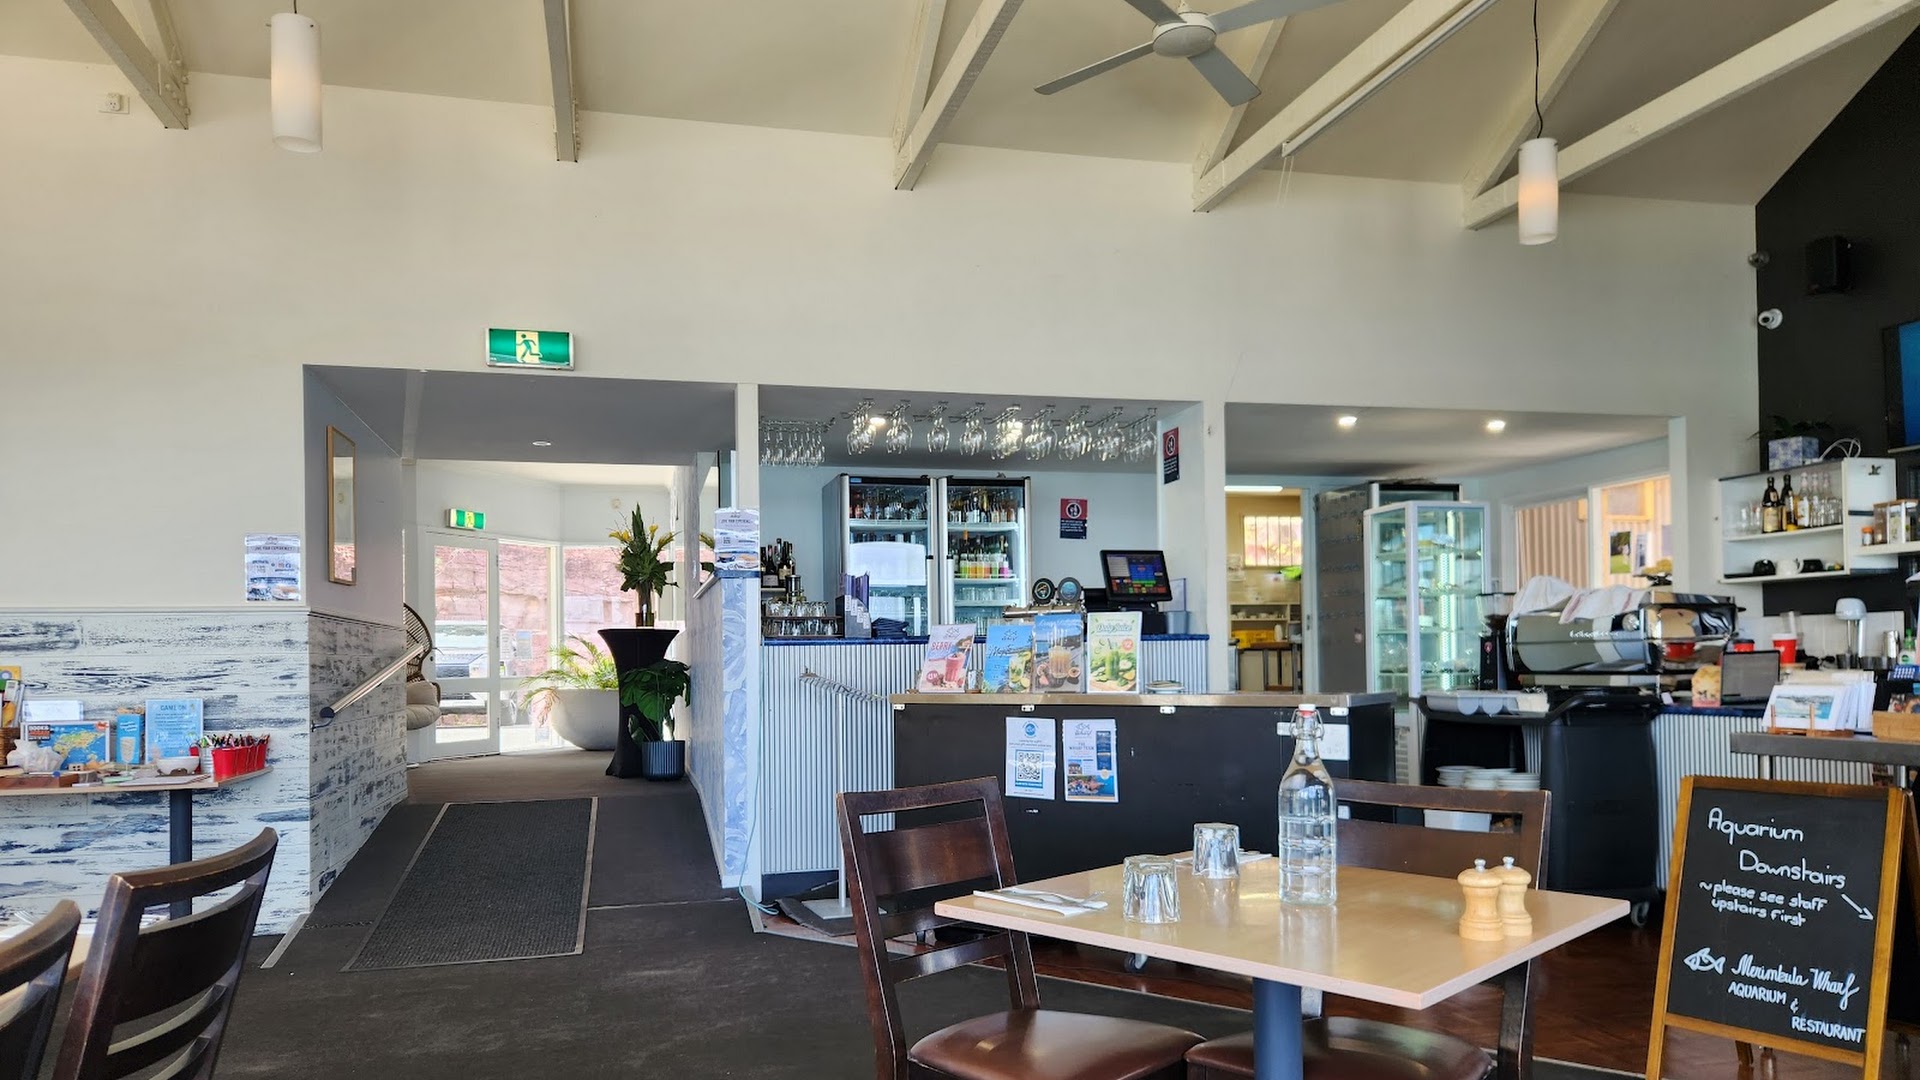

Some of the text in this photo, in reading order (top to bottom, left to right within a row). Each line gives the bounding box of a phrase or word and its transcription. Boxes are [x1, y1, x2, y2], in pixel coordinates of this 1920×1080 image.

[1708, 807, 1804, 845] Aquarium
[1739, 849, 1846, 889] Downstairs
[1711, 898, 1767, 918] upstairs
[1759, 891, 1785, 904] see
[1788, 892, 1828, 911] staff
[1727, 981, 1787, 1005] AQUARIUM
[1731, 953, 1860, 1011] Merimbula Wharf
[1791, 1016, 1867, 1043] RESTAURANT
